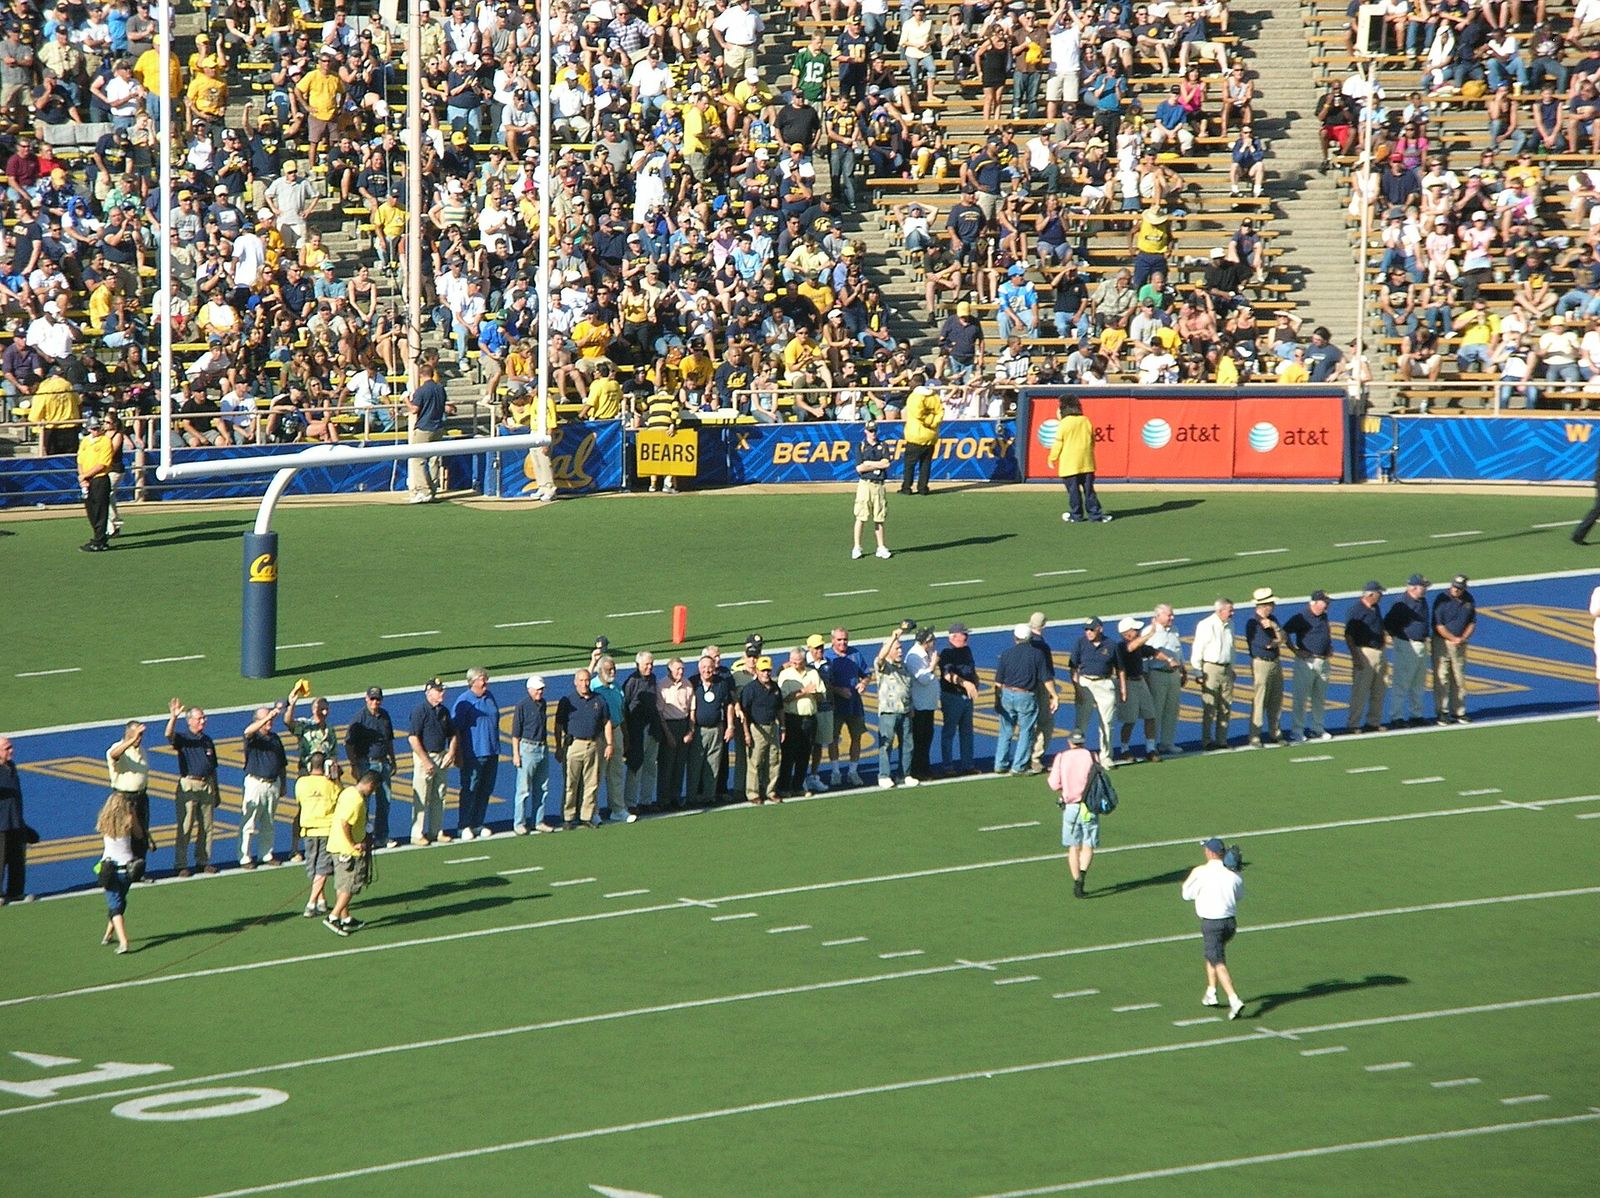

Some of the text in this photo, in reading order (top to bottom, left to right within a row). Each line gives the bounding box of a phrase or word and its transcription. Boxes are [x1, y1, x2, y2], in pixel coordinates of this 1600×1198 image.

[804, 61, 825, 83] 12
[726, 371, 747, 389] Cal
[1176, 424, 1221, 443] at&t
[1283, 427, 1329, 446] at&t
[1565, 423, 1593, 443] W
[640, 443, 695, 463] BEARS
[773, 440, 851, 464] BEAR
